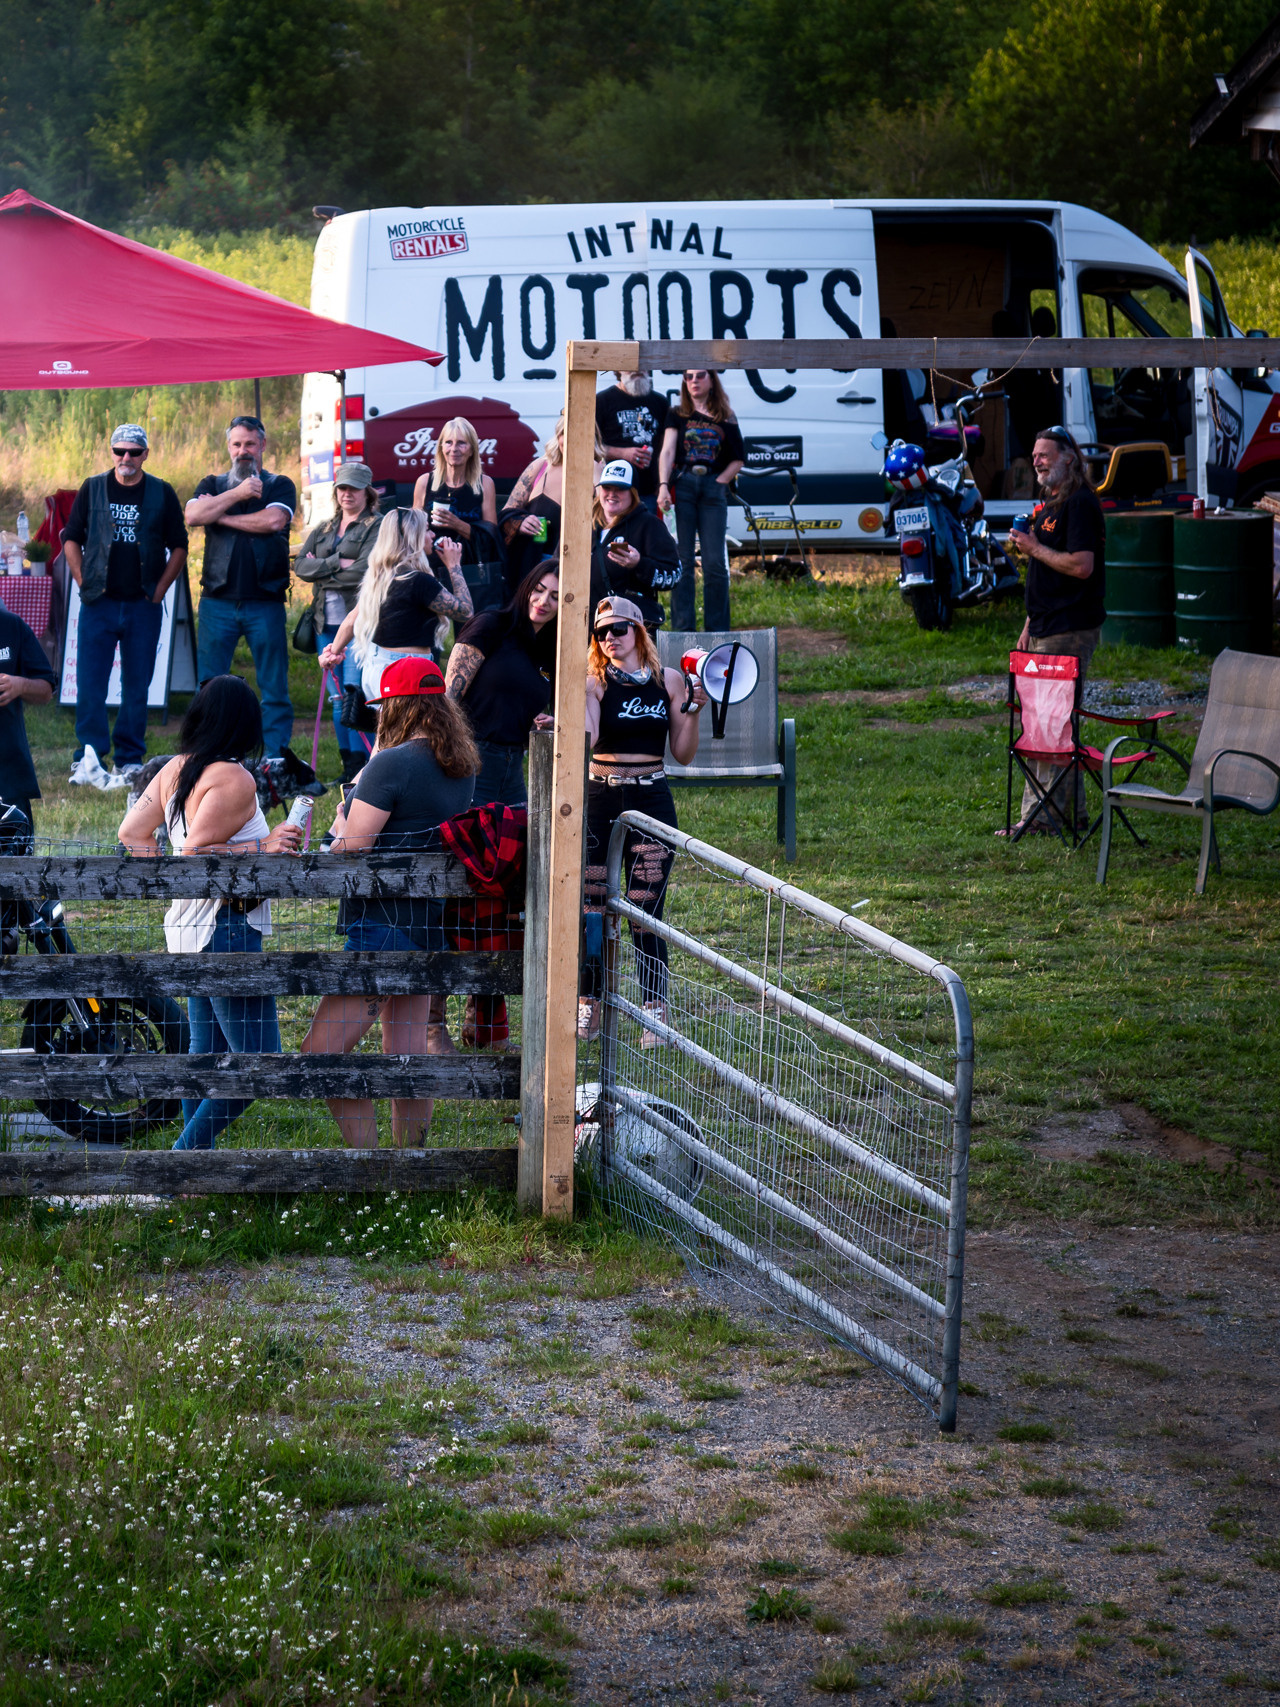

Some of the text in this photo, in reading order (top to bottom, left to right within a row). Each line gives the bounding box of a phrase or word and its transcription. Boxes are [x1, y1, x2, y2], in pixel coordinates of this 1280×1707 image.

[387, 217, 466, 239] MOTORCYCLE
[394, 234, 465, 258] RENTALS
[747, 452, 799, 461] MOTO GUZZI
[110, 503, 137, 512] FUCK
[114, 526, 136, 534] UCK
[618, 697, 668, 720] Lords
